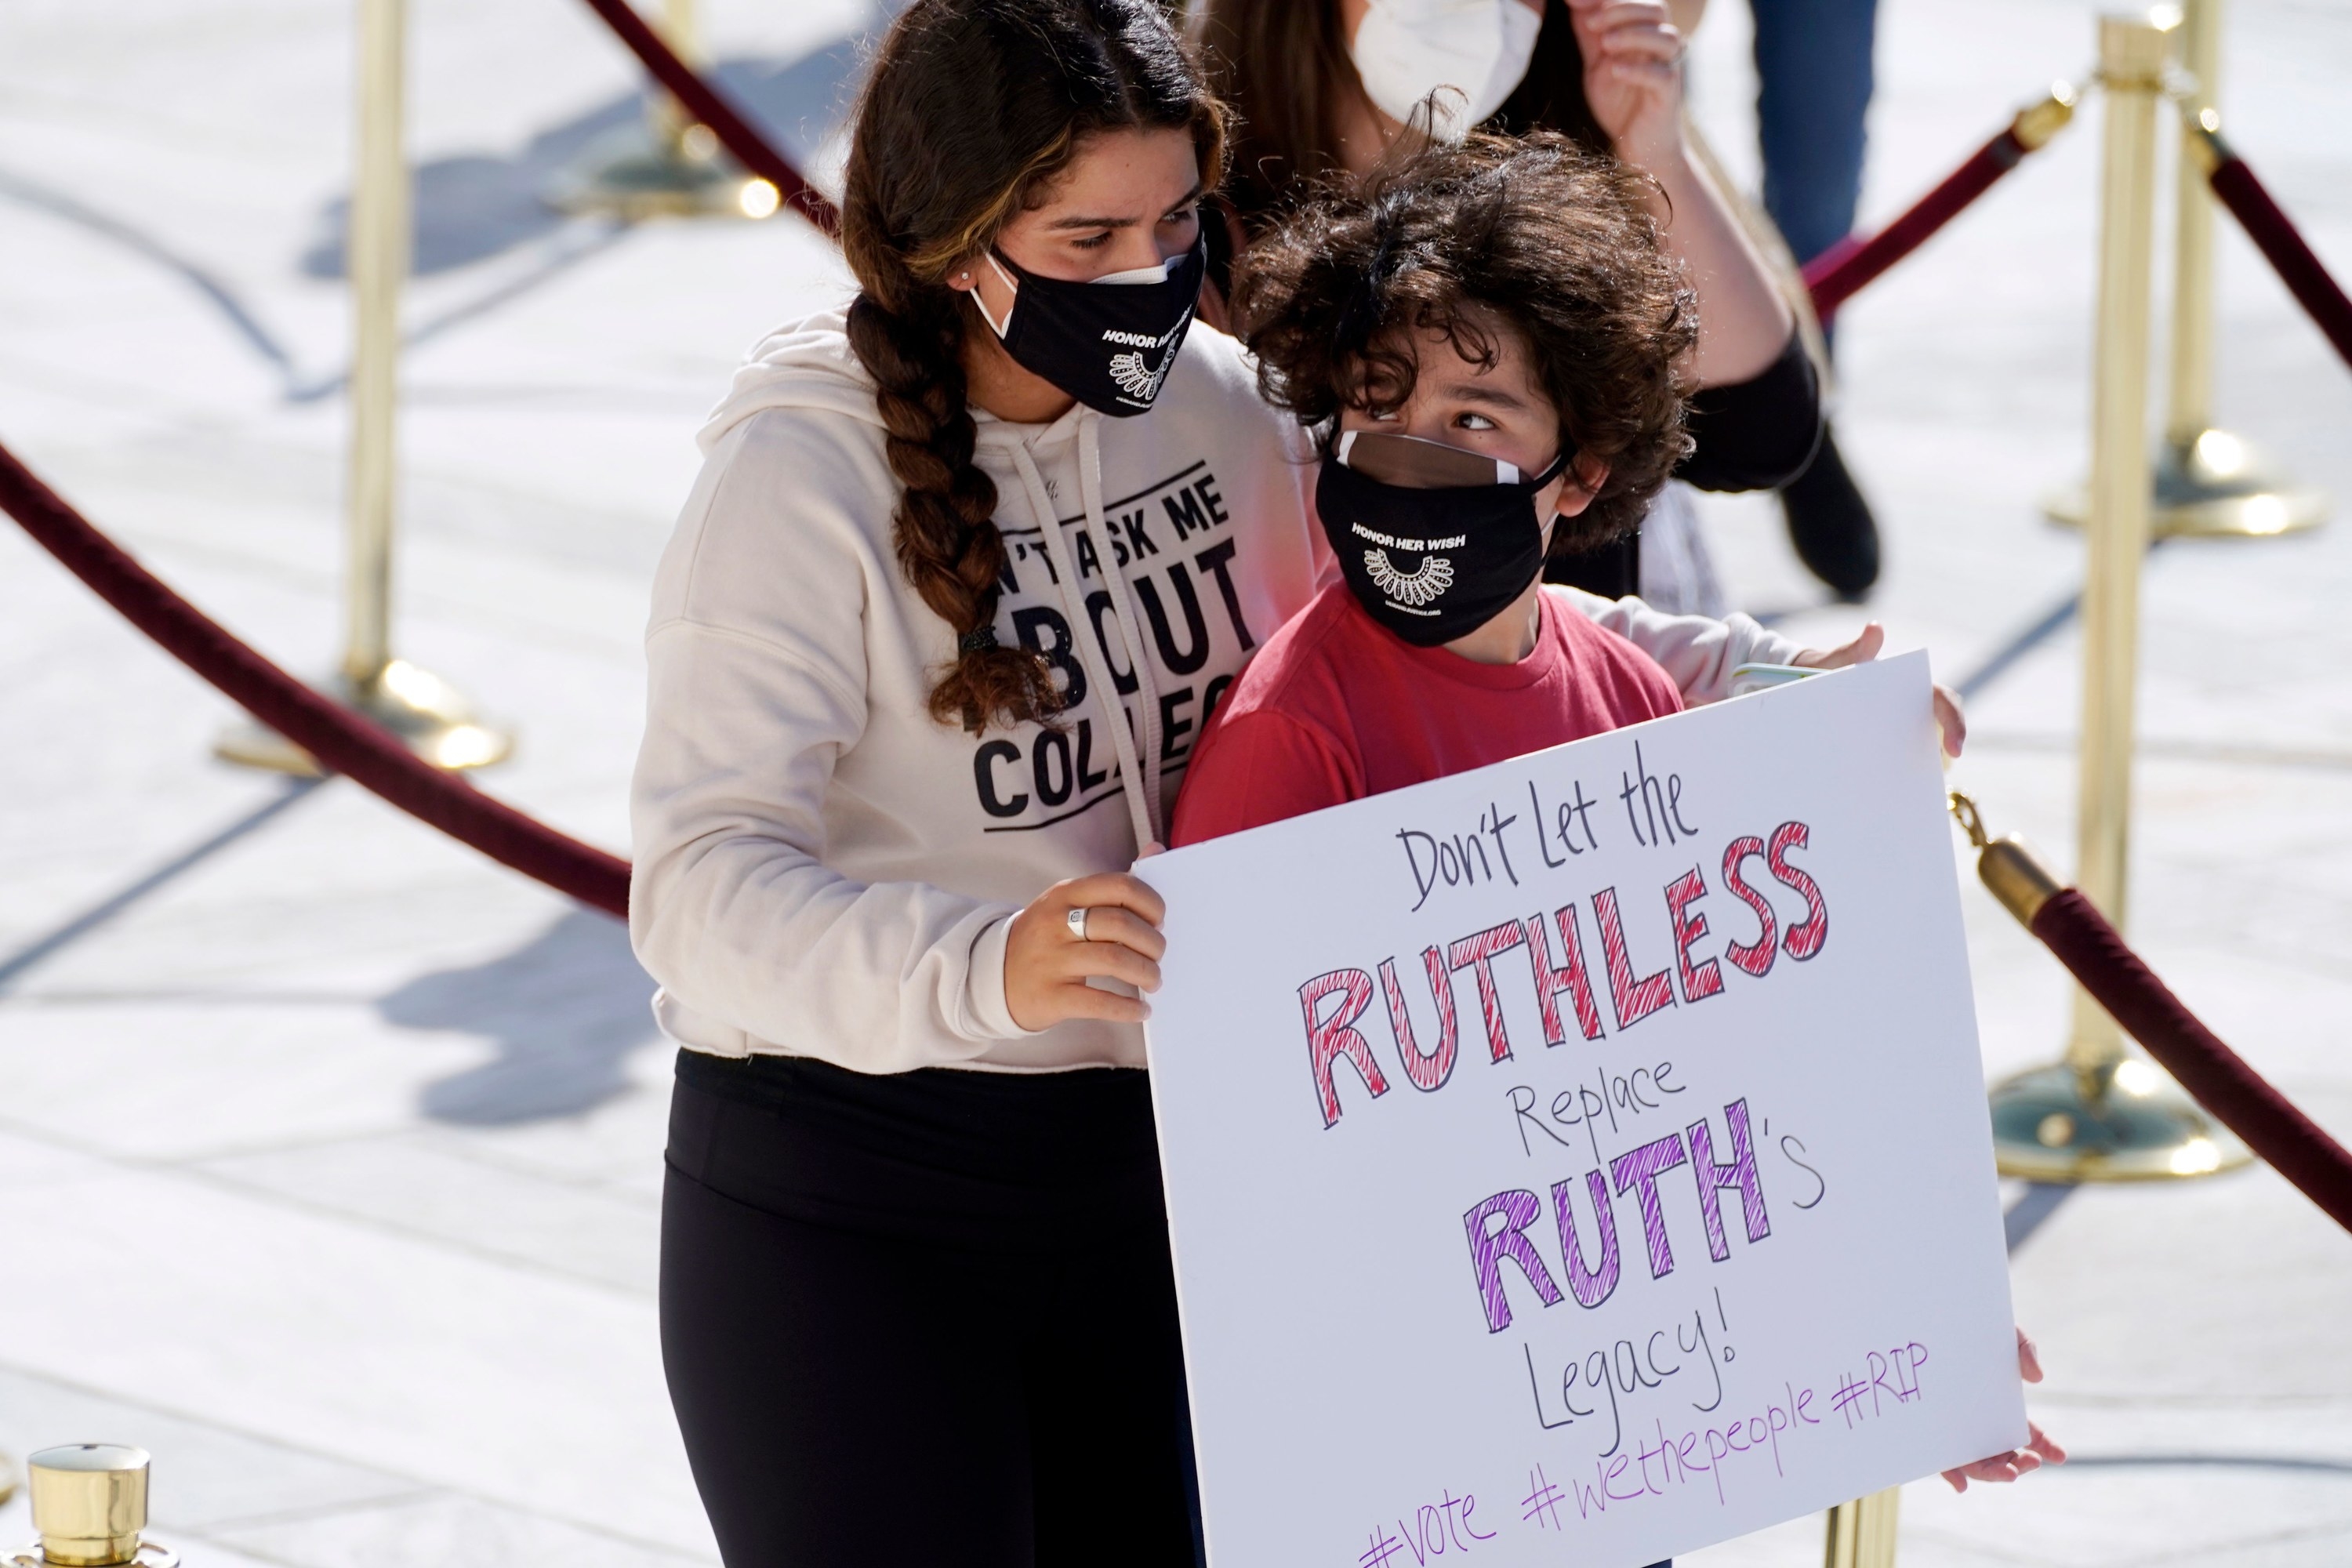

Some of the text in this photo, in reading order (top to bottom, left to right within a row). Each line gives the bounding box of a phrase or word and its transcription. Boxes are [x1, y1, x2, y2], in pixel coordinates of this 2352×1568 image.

[1102, 329, 1157, 349] HONOR
[996, 474, 1230, 597] N'T ASK ME
[1351, 522, 1466, 552] HONOR HER WISH
[1004, 536, 1256, 712] BOUT
[1396, 739, 1699, 912] Don't Let the
[1296, 820, 1828, 1131] RUTHLESS
[1506, 1062, 1687, 1165] Replace
[1359, 1341, 1929, 1568] #vote #wethepeople #RIP
[1524, 1286, 1736, 1457] Legacy!
